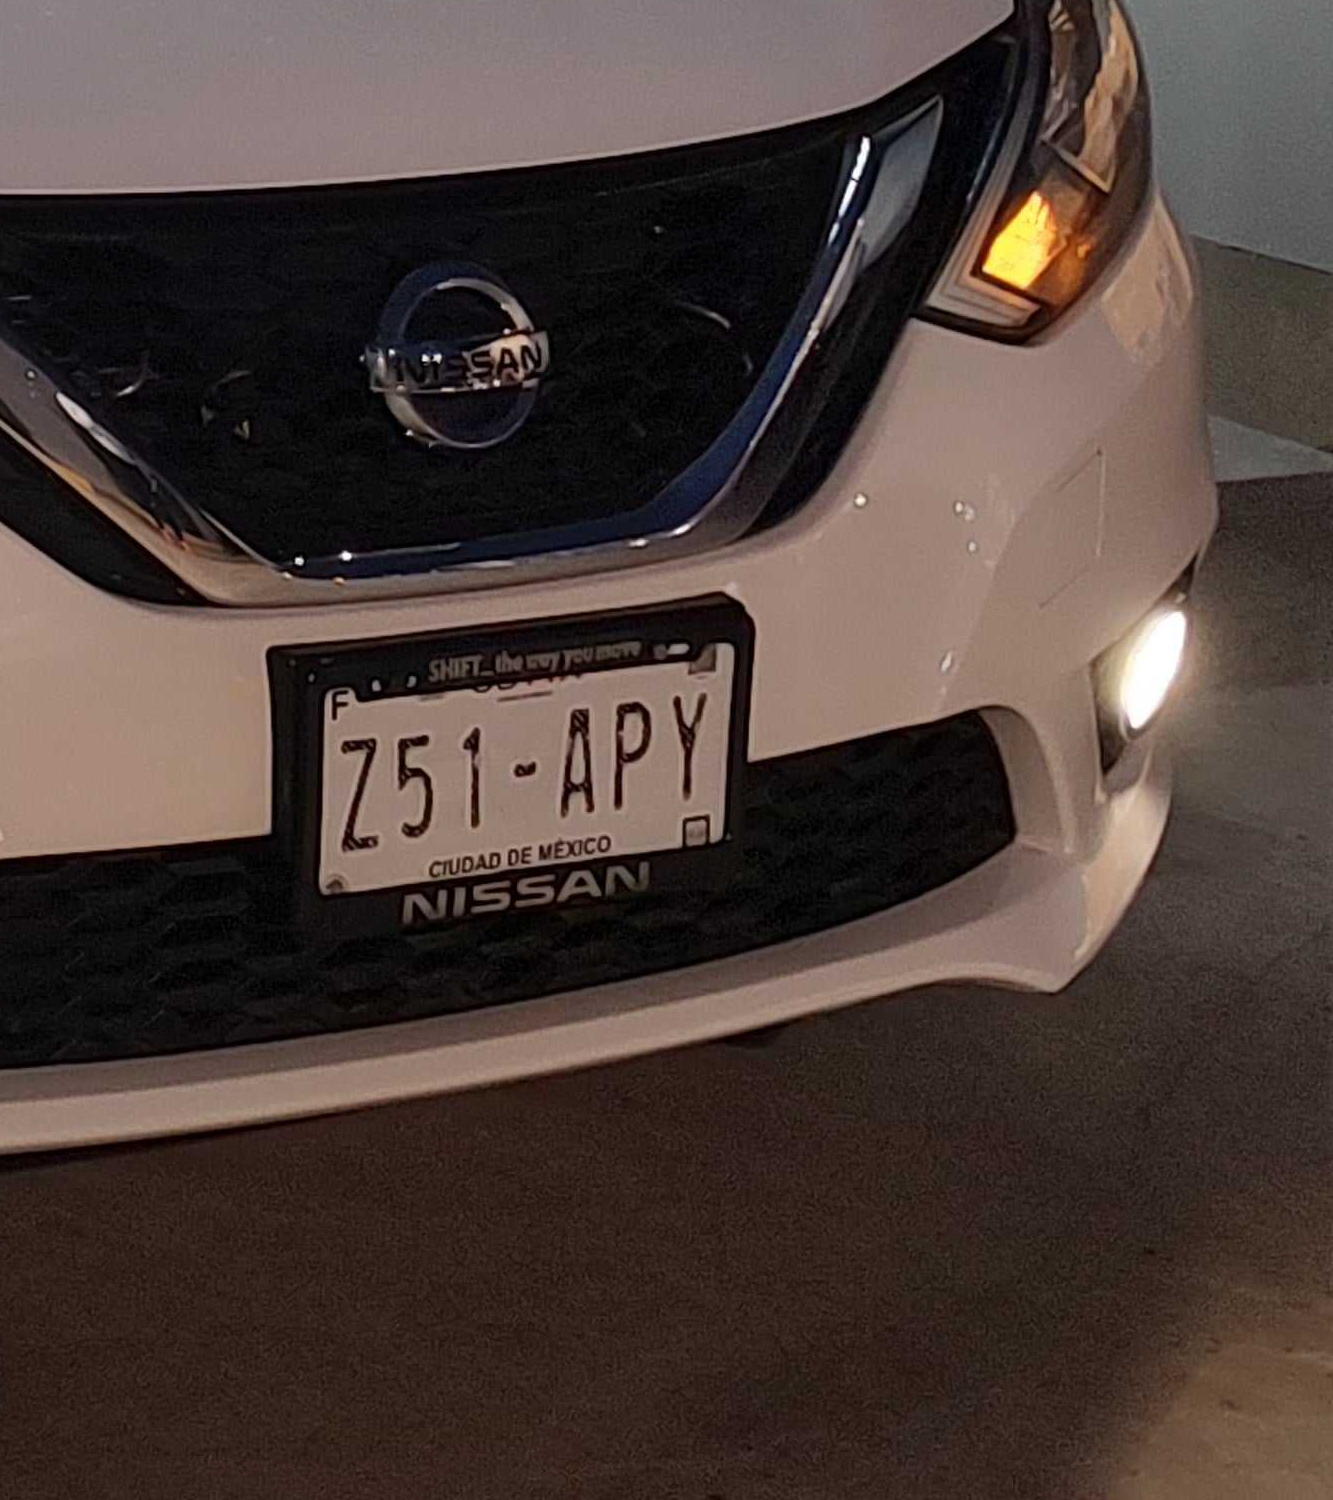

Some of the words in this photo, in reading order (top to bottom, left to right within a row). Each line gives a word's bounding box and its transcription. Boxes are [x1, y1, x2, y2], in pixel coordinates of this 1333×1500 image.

[339, 692, 709, 853] Z51-APY
[428, 852, 502, 878] CIUDAD
[507, 846, 533, 867] DE
[538, 835, 612, 861] MÉXICO
[401, 860, 651, 925] NISSAN
